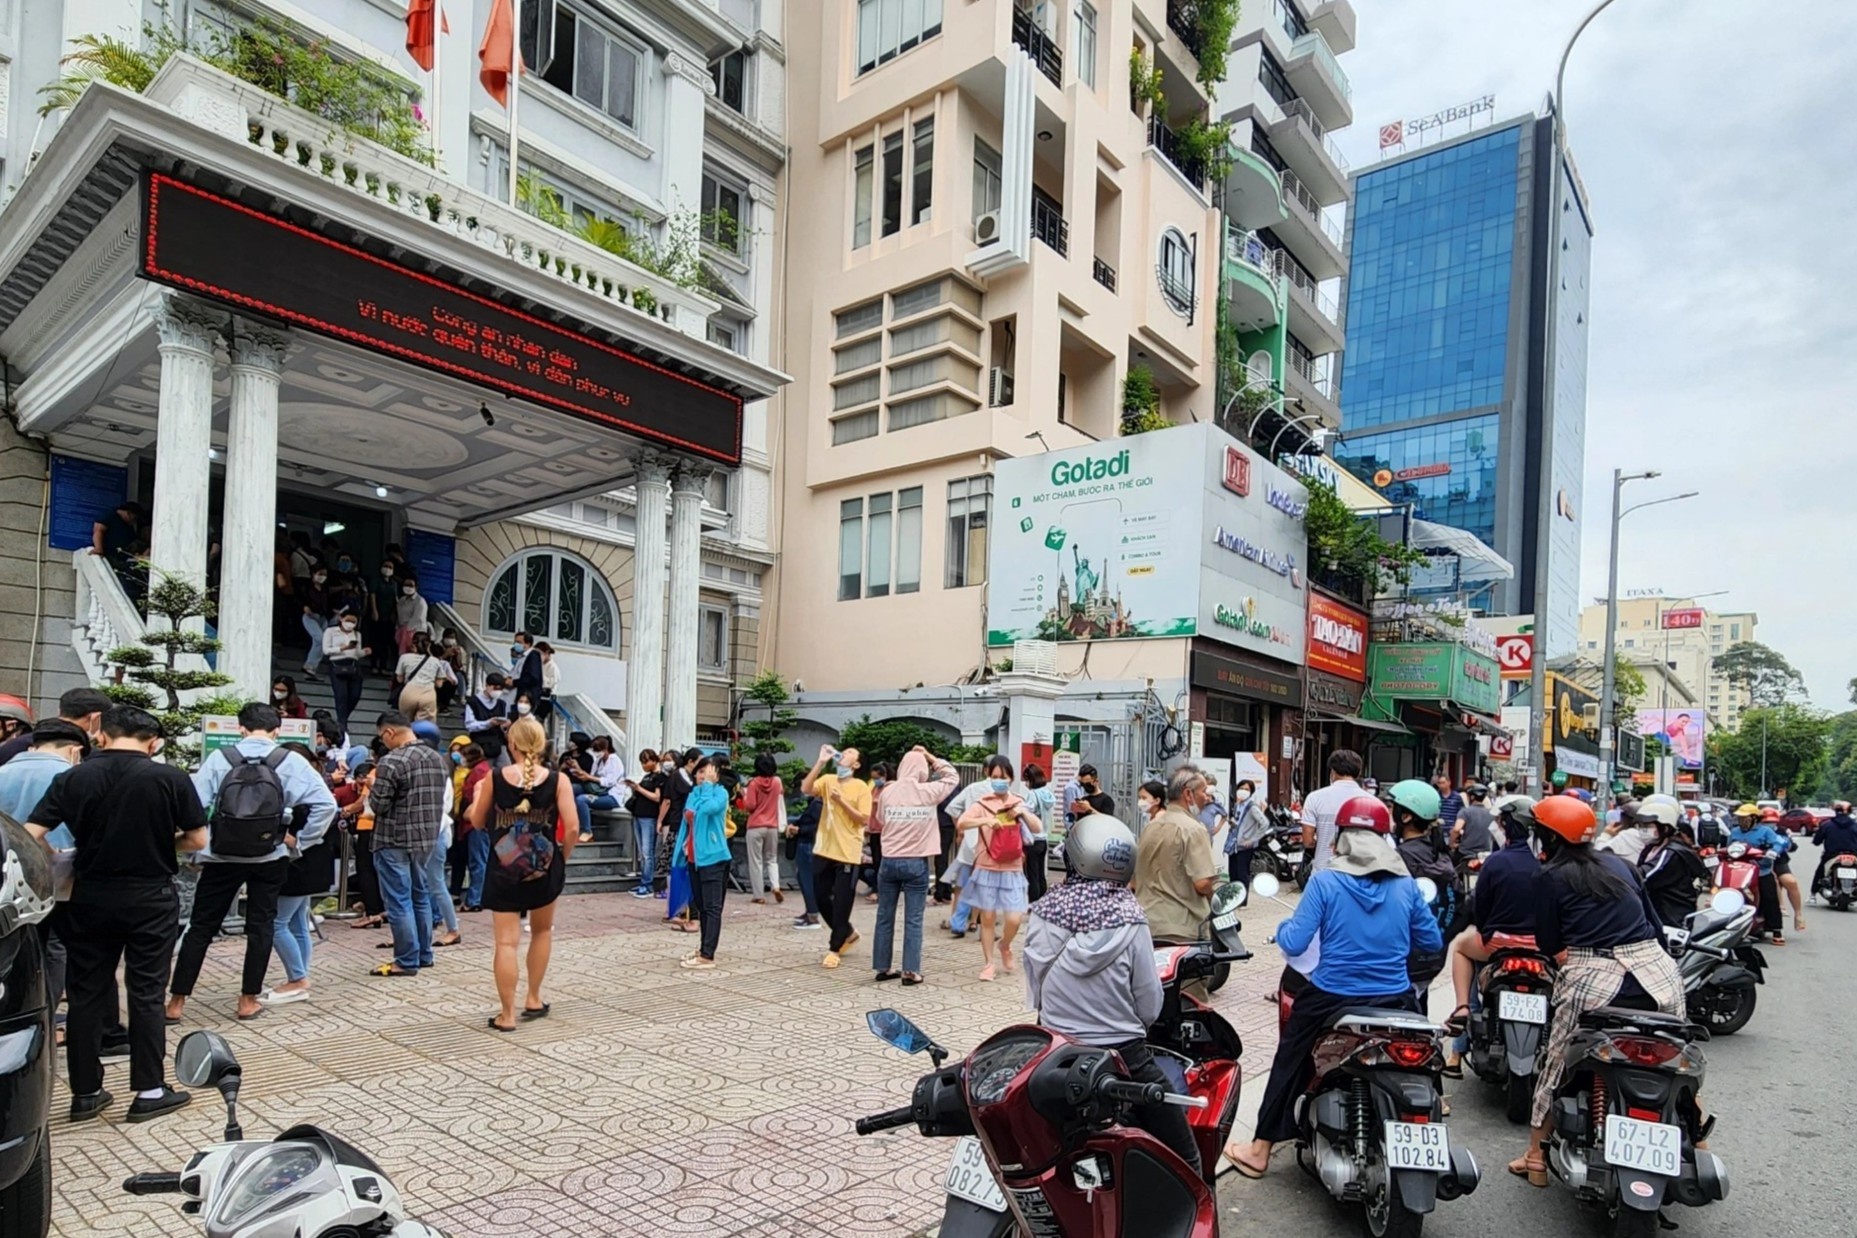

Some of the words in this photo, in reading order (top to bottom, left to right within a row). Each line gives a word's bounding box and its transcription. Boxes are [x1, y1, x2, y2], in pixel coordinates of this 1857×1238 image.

[1407, 94, 1495, 136] SeABank
[1051, 450, 1130, 486] Gotadi
[1503, 1006, 1543, 1022] 174.08
[1506, 994, 1540, 1009] 59-F2
[1394, 1124, 1440, 1146] 59-D3
[1618, 1121, 1670, 1149] 67-L2
[1393, 1146, 1446, 1168] 102.84
[1611, 1140, 1676, 1171] 407.09
